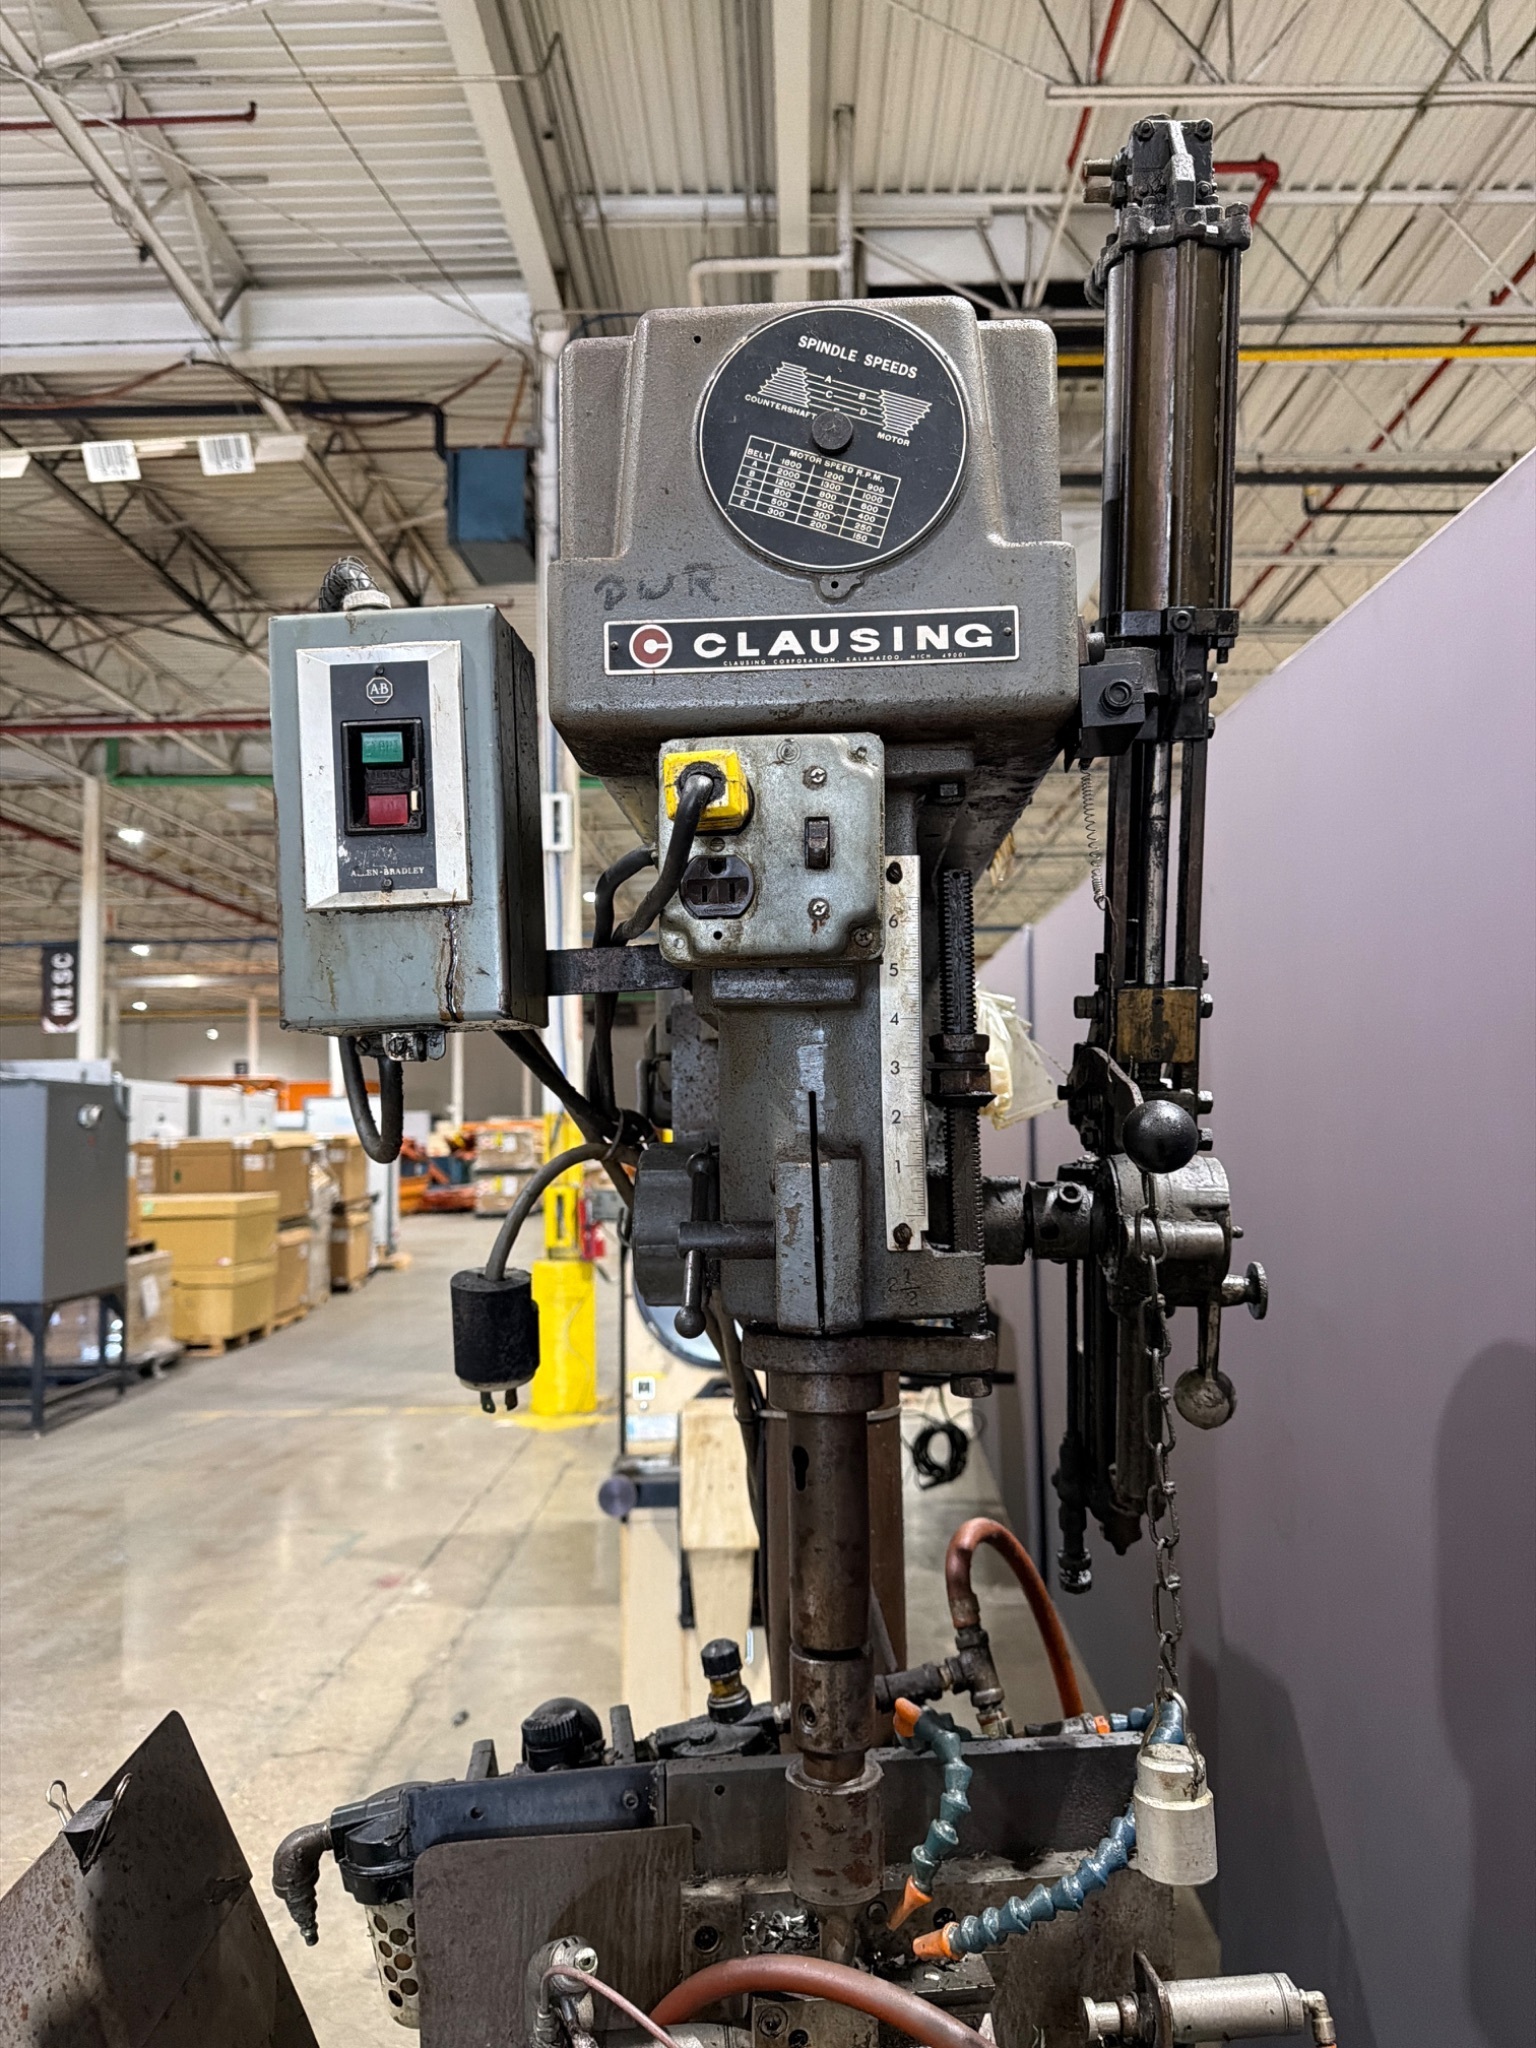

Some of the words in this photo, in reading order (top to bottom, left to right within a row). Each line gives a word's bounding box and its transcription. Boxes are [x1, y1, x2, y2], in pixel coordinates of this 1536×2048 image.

[798, 335, 858, 362] SPINDLE
[864, 354, 917, 378] SPEEDS
[825, 375, 832, 383] A
[745, 394, 818, 420] COUNTERSHAFT
[858, 392, 866, 400] B
[877, 432, 910, 446] MOTOR
[747, 448, 770, 459] BELT
[824, 470, 844, 481] 1200
[867, 483, 885, 493] 900
[789, 450, 822, 463] MOTOR
[824, 460, 854, 473] SPEED
[856, 470, 882, 482] R.P.M.
[775, 478, 796, 489] 1200
[819, 492, 837, 500] 800
[777, 468, 800, 479] 2000
[821, 481, 841, 491] 1300
[862, 493, 883, 503] 1000
[774, 488, 791, 498] 800
[858, 513, 875, 522] 400
[767, 508, 785, 517] 300
[810, 520, 827, 530] 200
[853, 533, 868, 542] 150
[813, 511, 830, 520] 300
[854, 523, 872, 532] 250
[694, 623, 993, 658] CLAUSING
[889, 914, 898, 928] 6
[889, 962, 899, 977] 5
[51, 952, 74, 1016] MISC
[890, 1012, 899, 1026] 4
[890, 1061, 900, 1075] 3
[892, 1109, 902, 1124] 2
